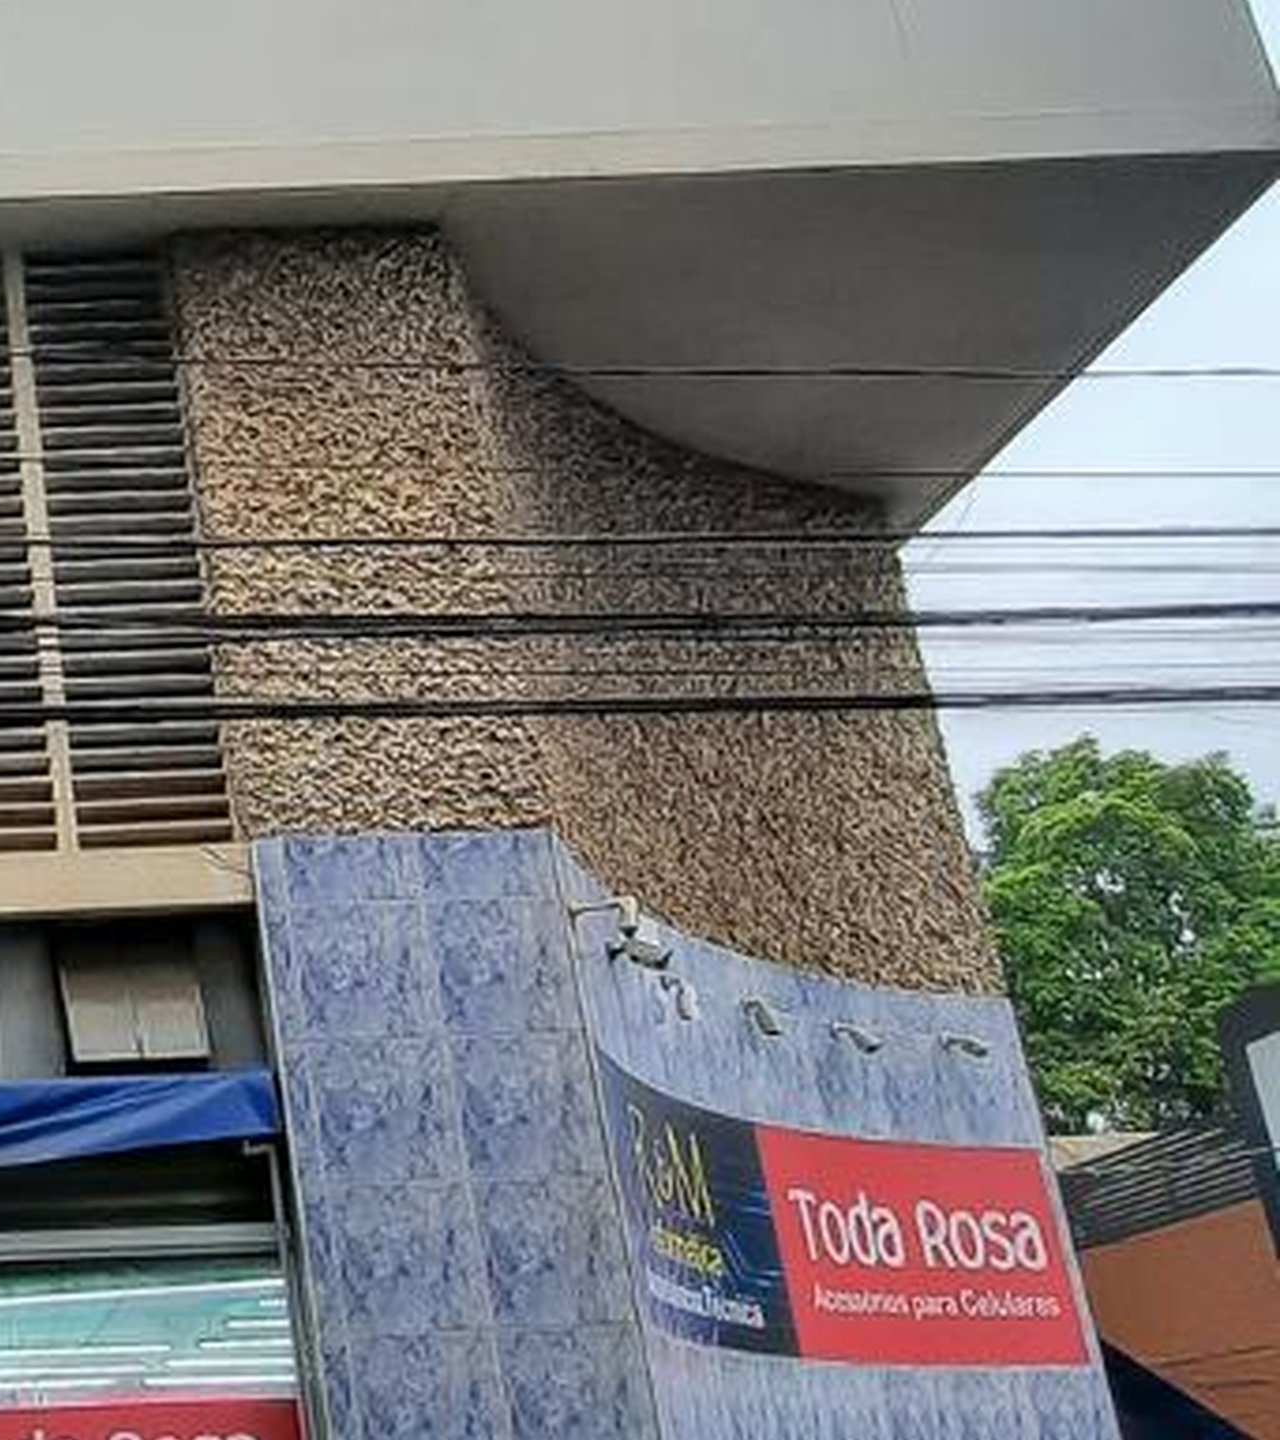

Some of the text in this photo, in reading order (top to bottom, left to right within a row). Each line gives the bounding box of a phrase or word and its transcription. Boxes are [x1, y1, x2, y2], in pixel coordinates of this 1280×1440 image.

[788, 1187, 906, 1268] Toda
[914, 1198, 1049, 1272] Rosa
[912, 1294, 958, 1320] para
